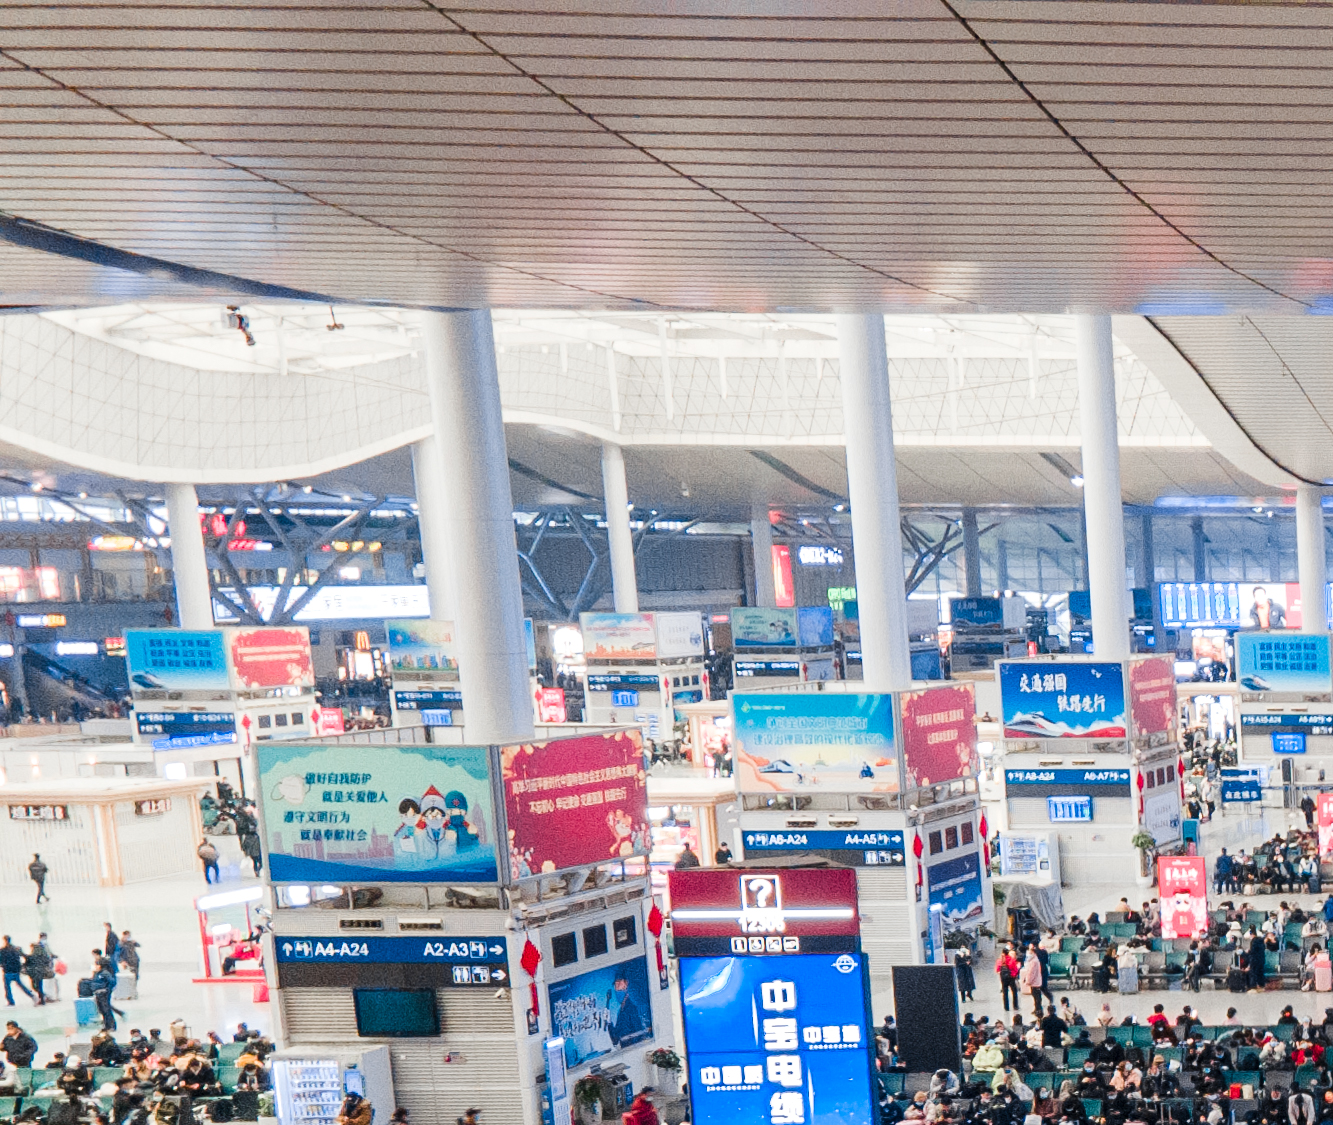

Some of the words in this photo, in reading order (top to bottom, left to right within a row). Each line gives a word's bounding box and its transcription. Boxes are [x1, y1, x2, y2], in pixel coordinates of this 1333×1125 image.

[1019, 672, 1067, 693] 交通强国
[1056, 693, 1106, 713] 铁路先行
[304, 772, 372, 785] 做好自我防护
[322, 790, 388, 803] 就是关爱他人
[283, 810, 350, 824] 遵守文明行为
[768, 834, 808, 845] A6-A24
[845, 834, 877, 844] A4-A5
[315, 942, 369, 957] A4-A24
[423, 942, 469, 957] A2-A3
